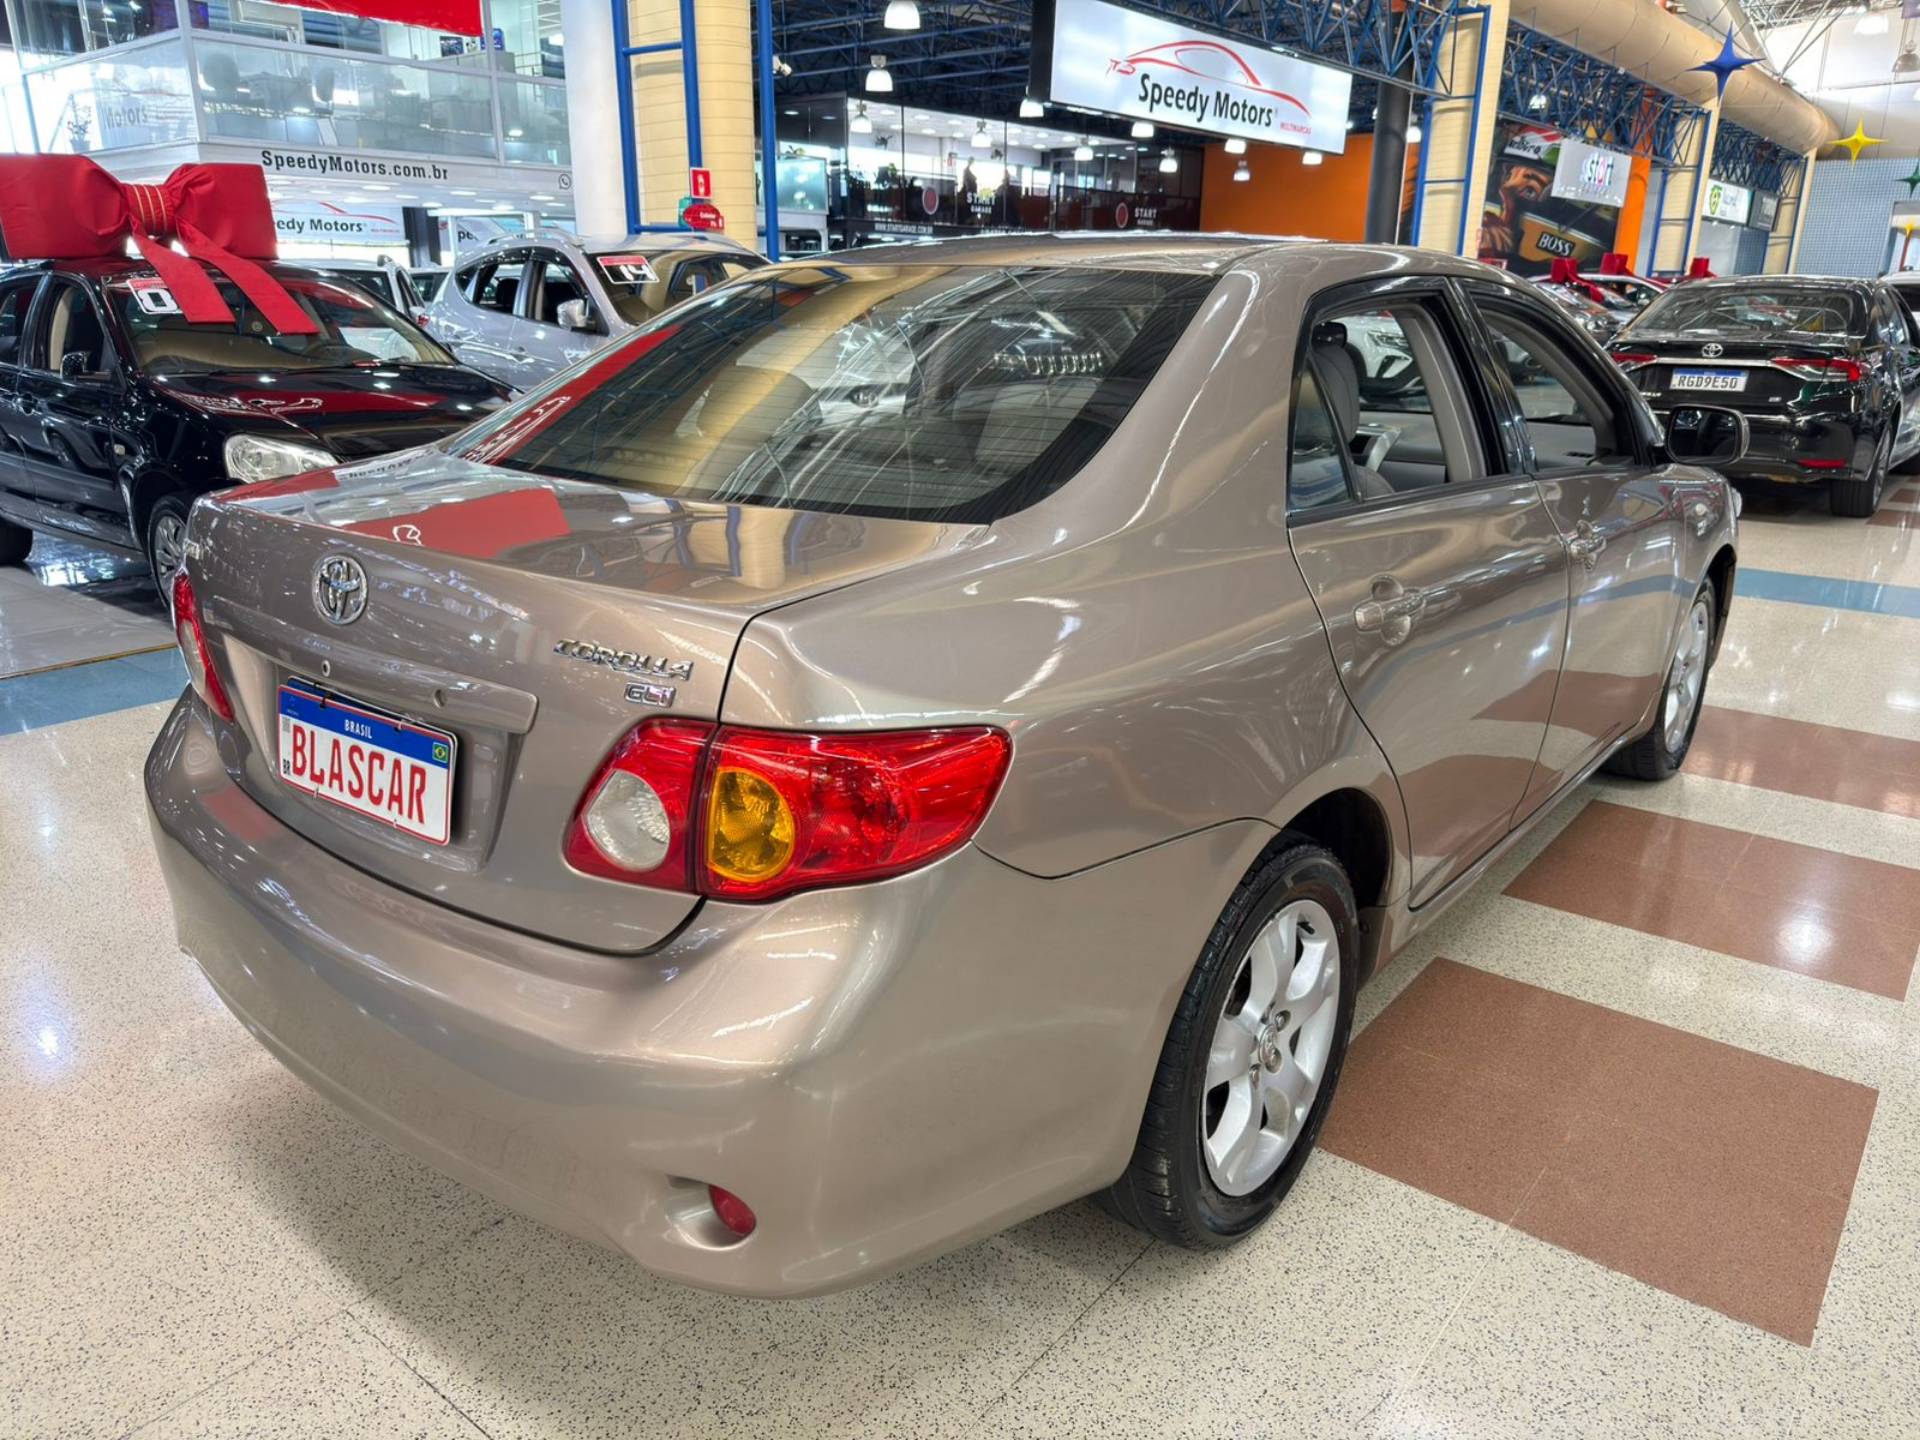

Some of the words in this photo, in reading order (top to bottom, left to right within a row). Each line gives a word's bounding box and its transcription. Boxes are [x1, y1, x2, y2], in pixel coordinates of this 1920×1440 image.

[1138, 73, 1210, 122] Speedy
[1212, 90, 1273, 127] Motors
[261, 150, 449, 180] SpeedyMotors.com.br
[309, 219, 363, 233] Motors
[1134, 207, 1157, 219] START
[1538, 233, 1573, 256] BOSS
[553, 638, 695, 681] COROLLA
[343, 719, 373, 740] BRASIL
[292, 723, 427, 825] BLASCAR
